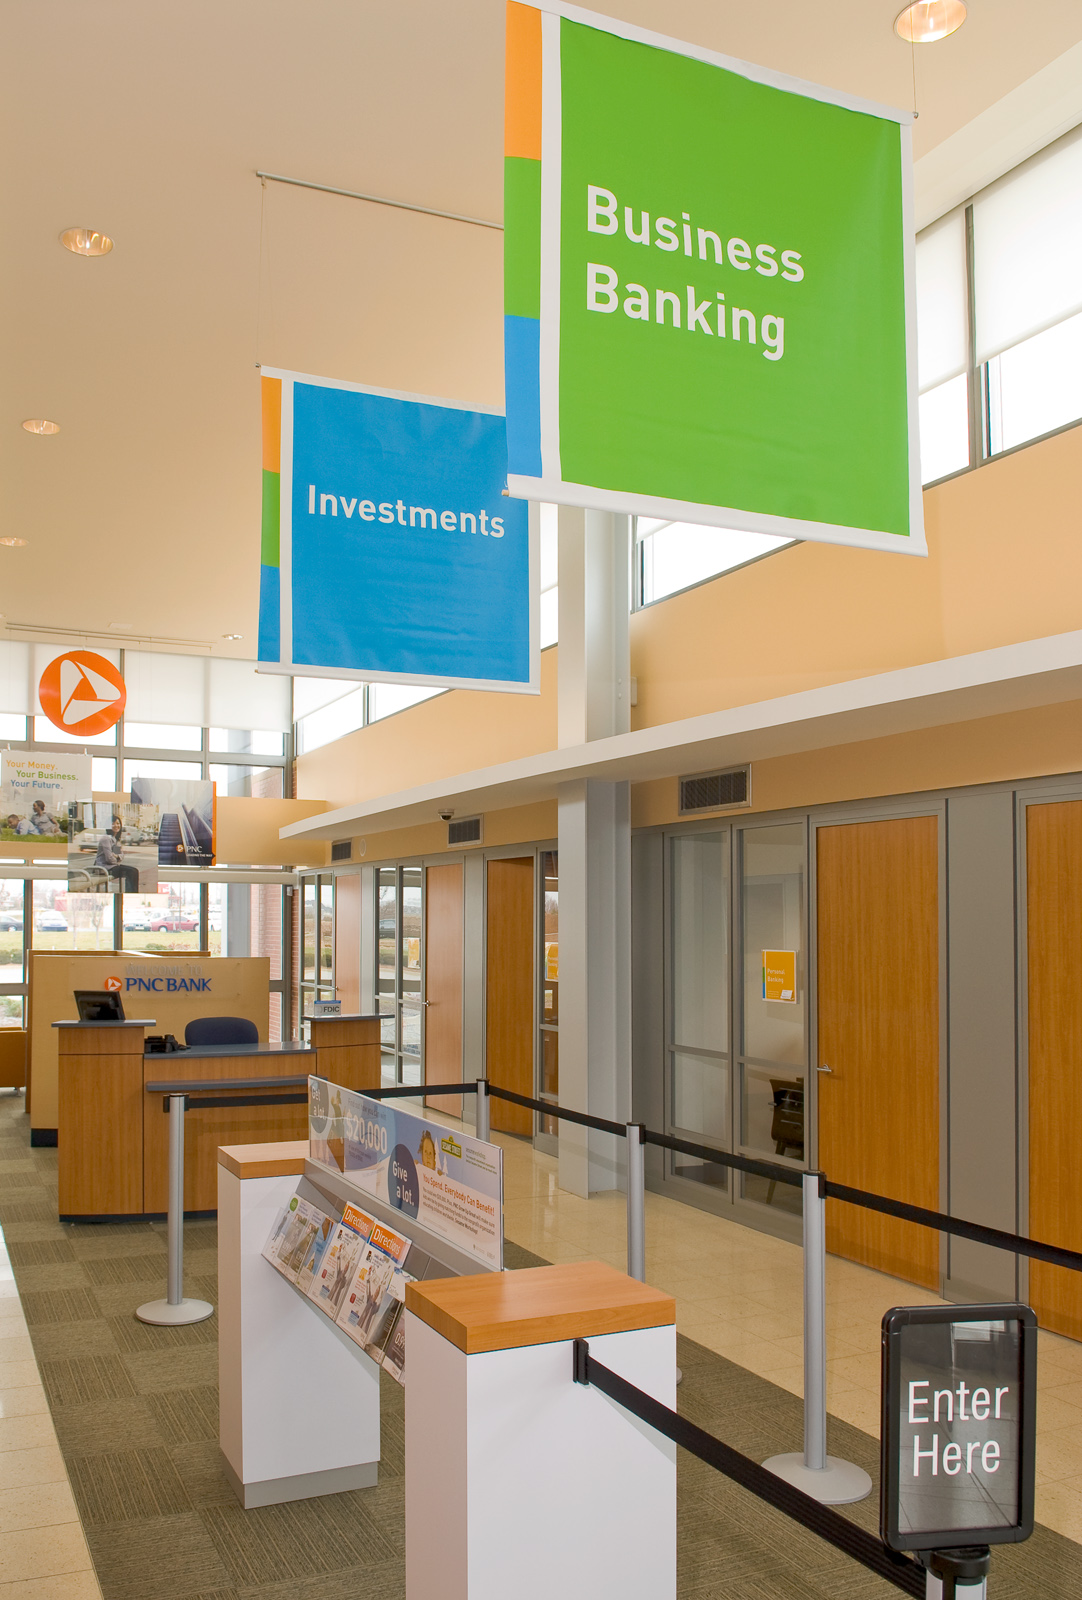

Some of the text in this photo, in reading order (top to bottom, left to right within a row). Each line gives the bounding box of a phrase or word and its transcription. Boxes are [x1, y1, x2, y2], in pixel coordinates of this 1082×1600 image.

[587, 183, 805, 283] Business
[586, 262, 785, 361] Banking
[308, 484, 505, 538] Investments
[6, 760, 58, 771] Your Money.
[16, 770, 79, 781] Your Business.
[10, 780, 63, 790] Your Future.
[186, 845, 203, 853] PNC
[126, 965, 203, 977] WELCOME TO
[767, 976, 784, 984] Banking
[124, 977, 212, 992] PNC BANK
[346, 1108, 388, 1155] $20,000
[392, 1160, 408, 1182] Give
[396, 1186, 401, 1199] a
[402, 1184, 415, 1207] lot.
[445, 1183, 466, 1204] Everybody
[467, 1195, 476, 1207] Can
[476, 1199, 495, 1217] Benefit!
[345, 1208, 370, 1234] Directions
[373, 1223, 401, 1256] Directions
[908, 1380, 1009, 1424] Enter
[912, 1433, 1000, 1477] Here
